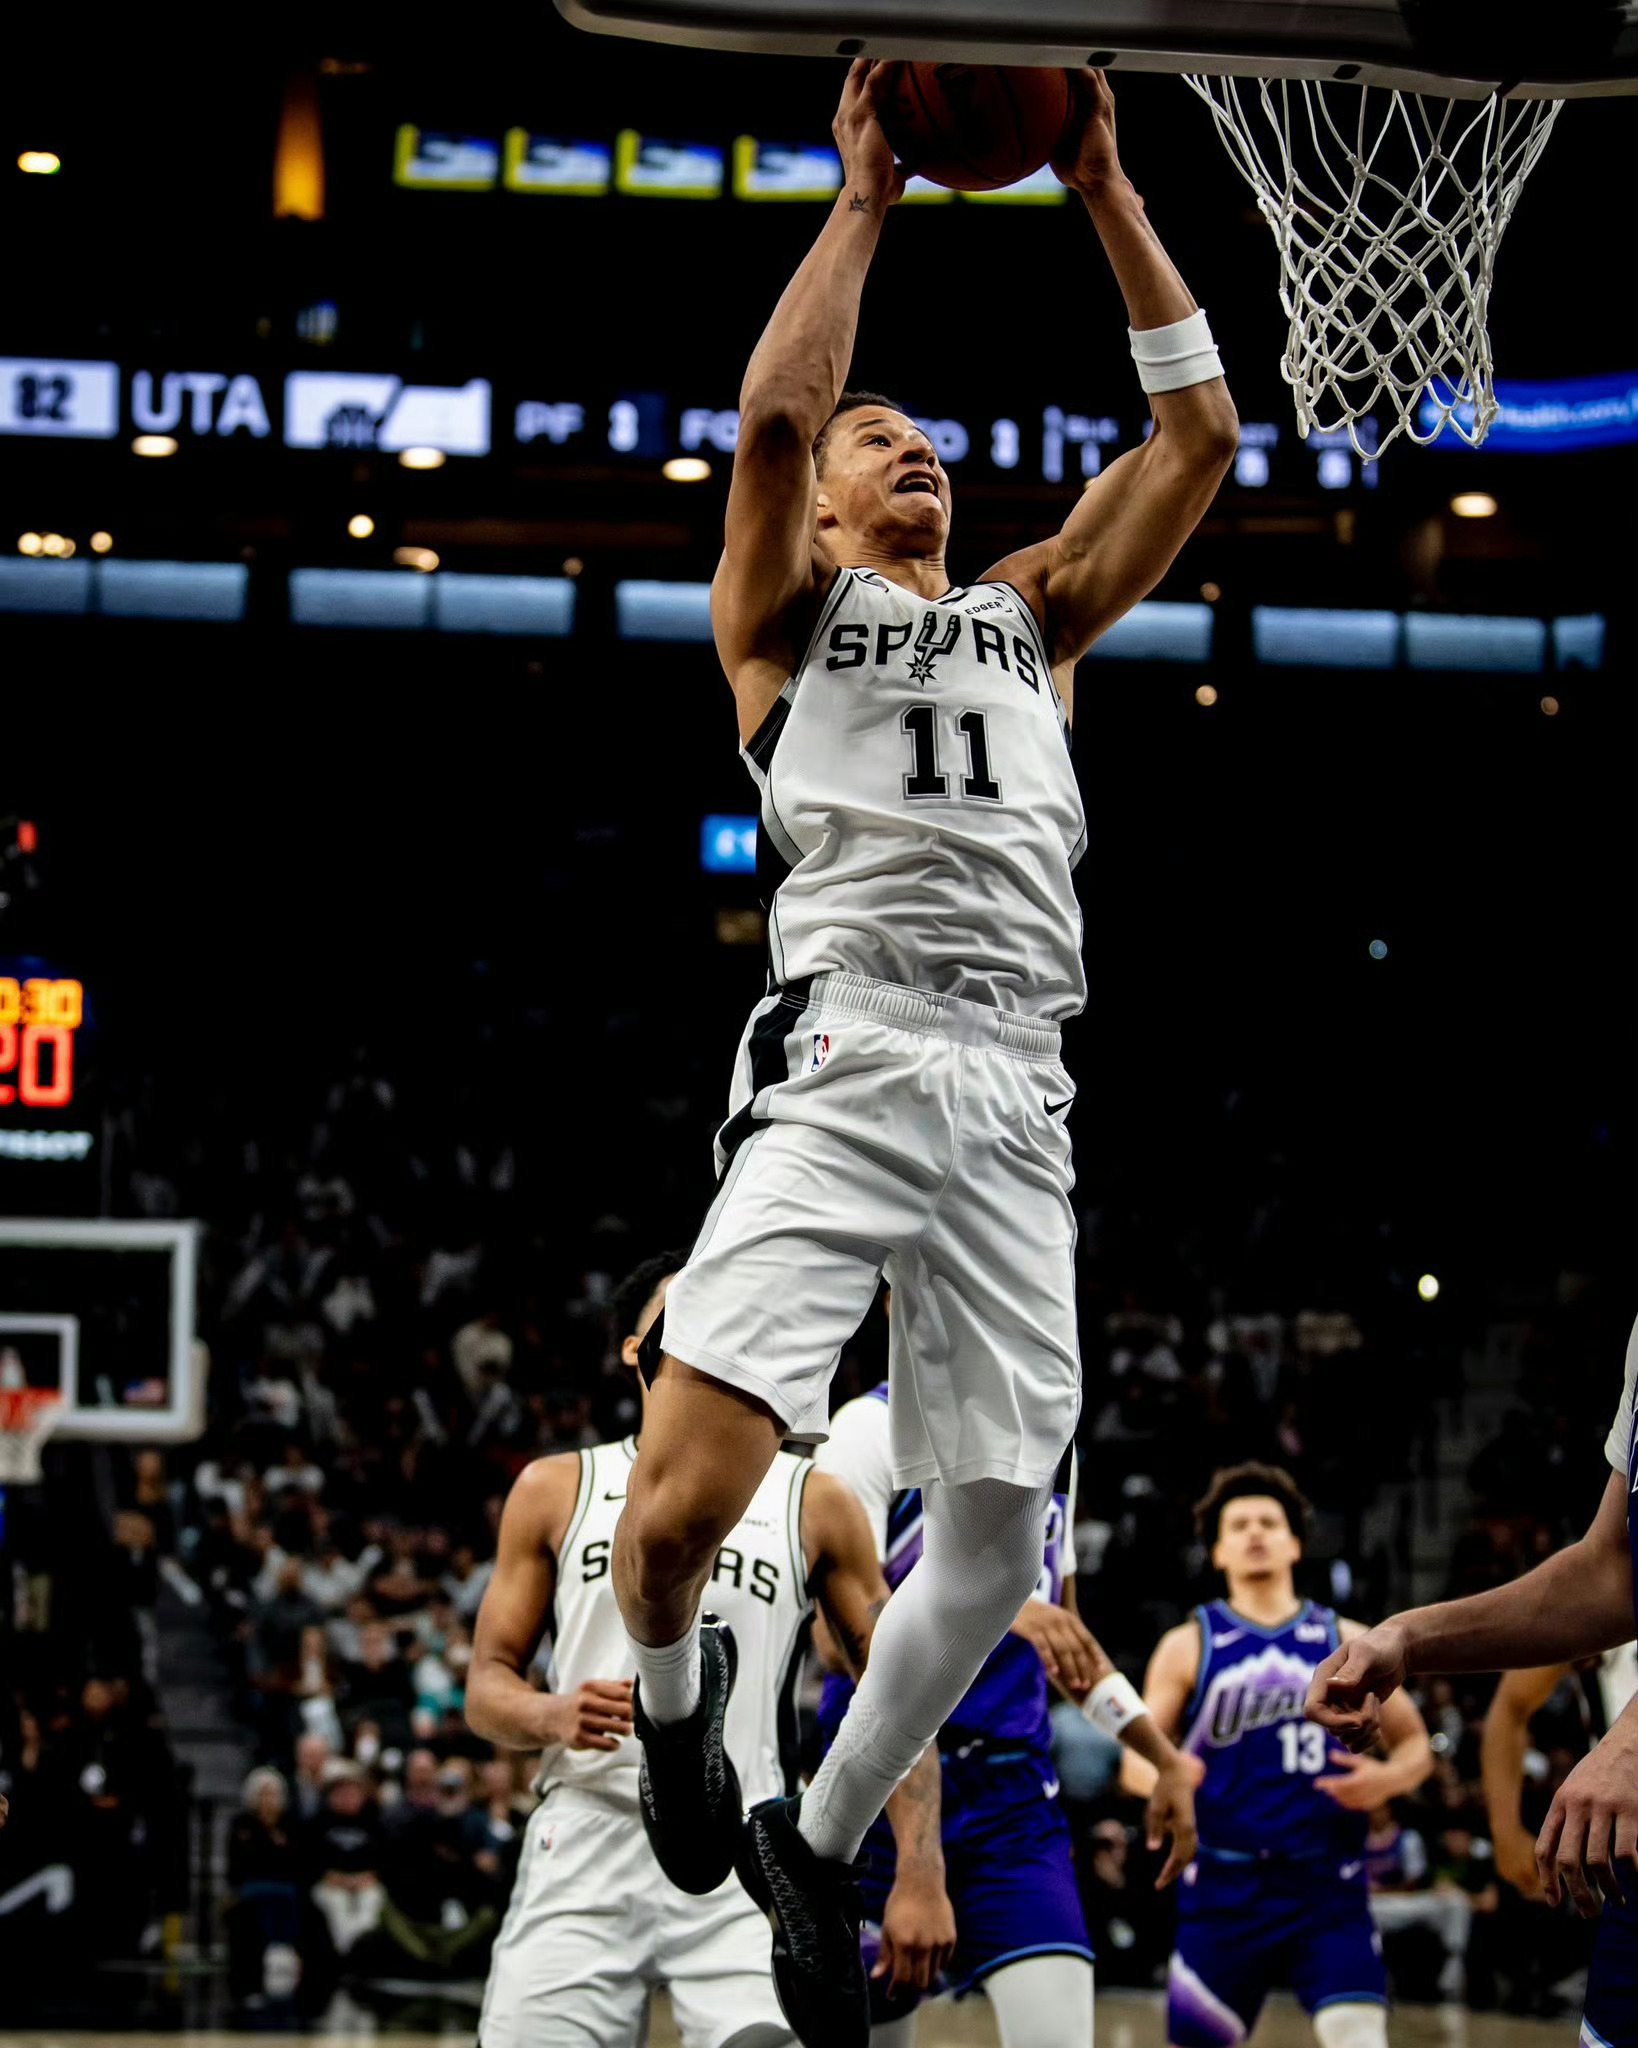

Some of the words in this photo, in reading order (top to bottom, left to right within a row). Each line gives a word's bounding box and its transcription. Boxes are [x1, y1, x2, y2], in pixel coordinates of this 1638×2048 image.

[132, 370, 271, 438] UTA
[964, 601, 1003, 615] EDGER
[826, 611, 1040, 694] SPURS
[900, 702, 1004, 804] 11
[582, 1540, 780, 1606] SRS
[1277, 1719, 1326, 1775] 13
